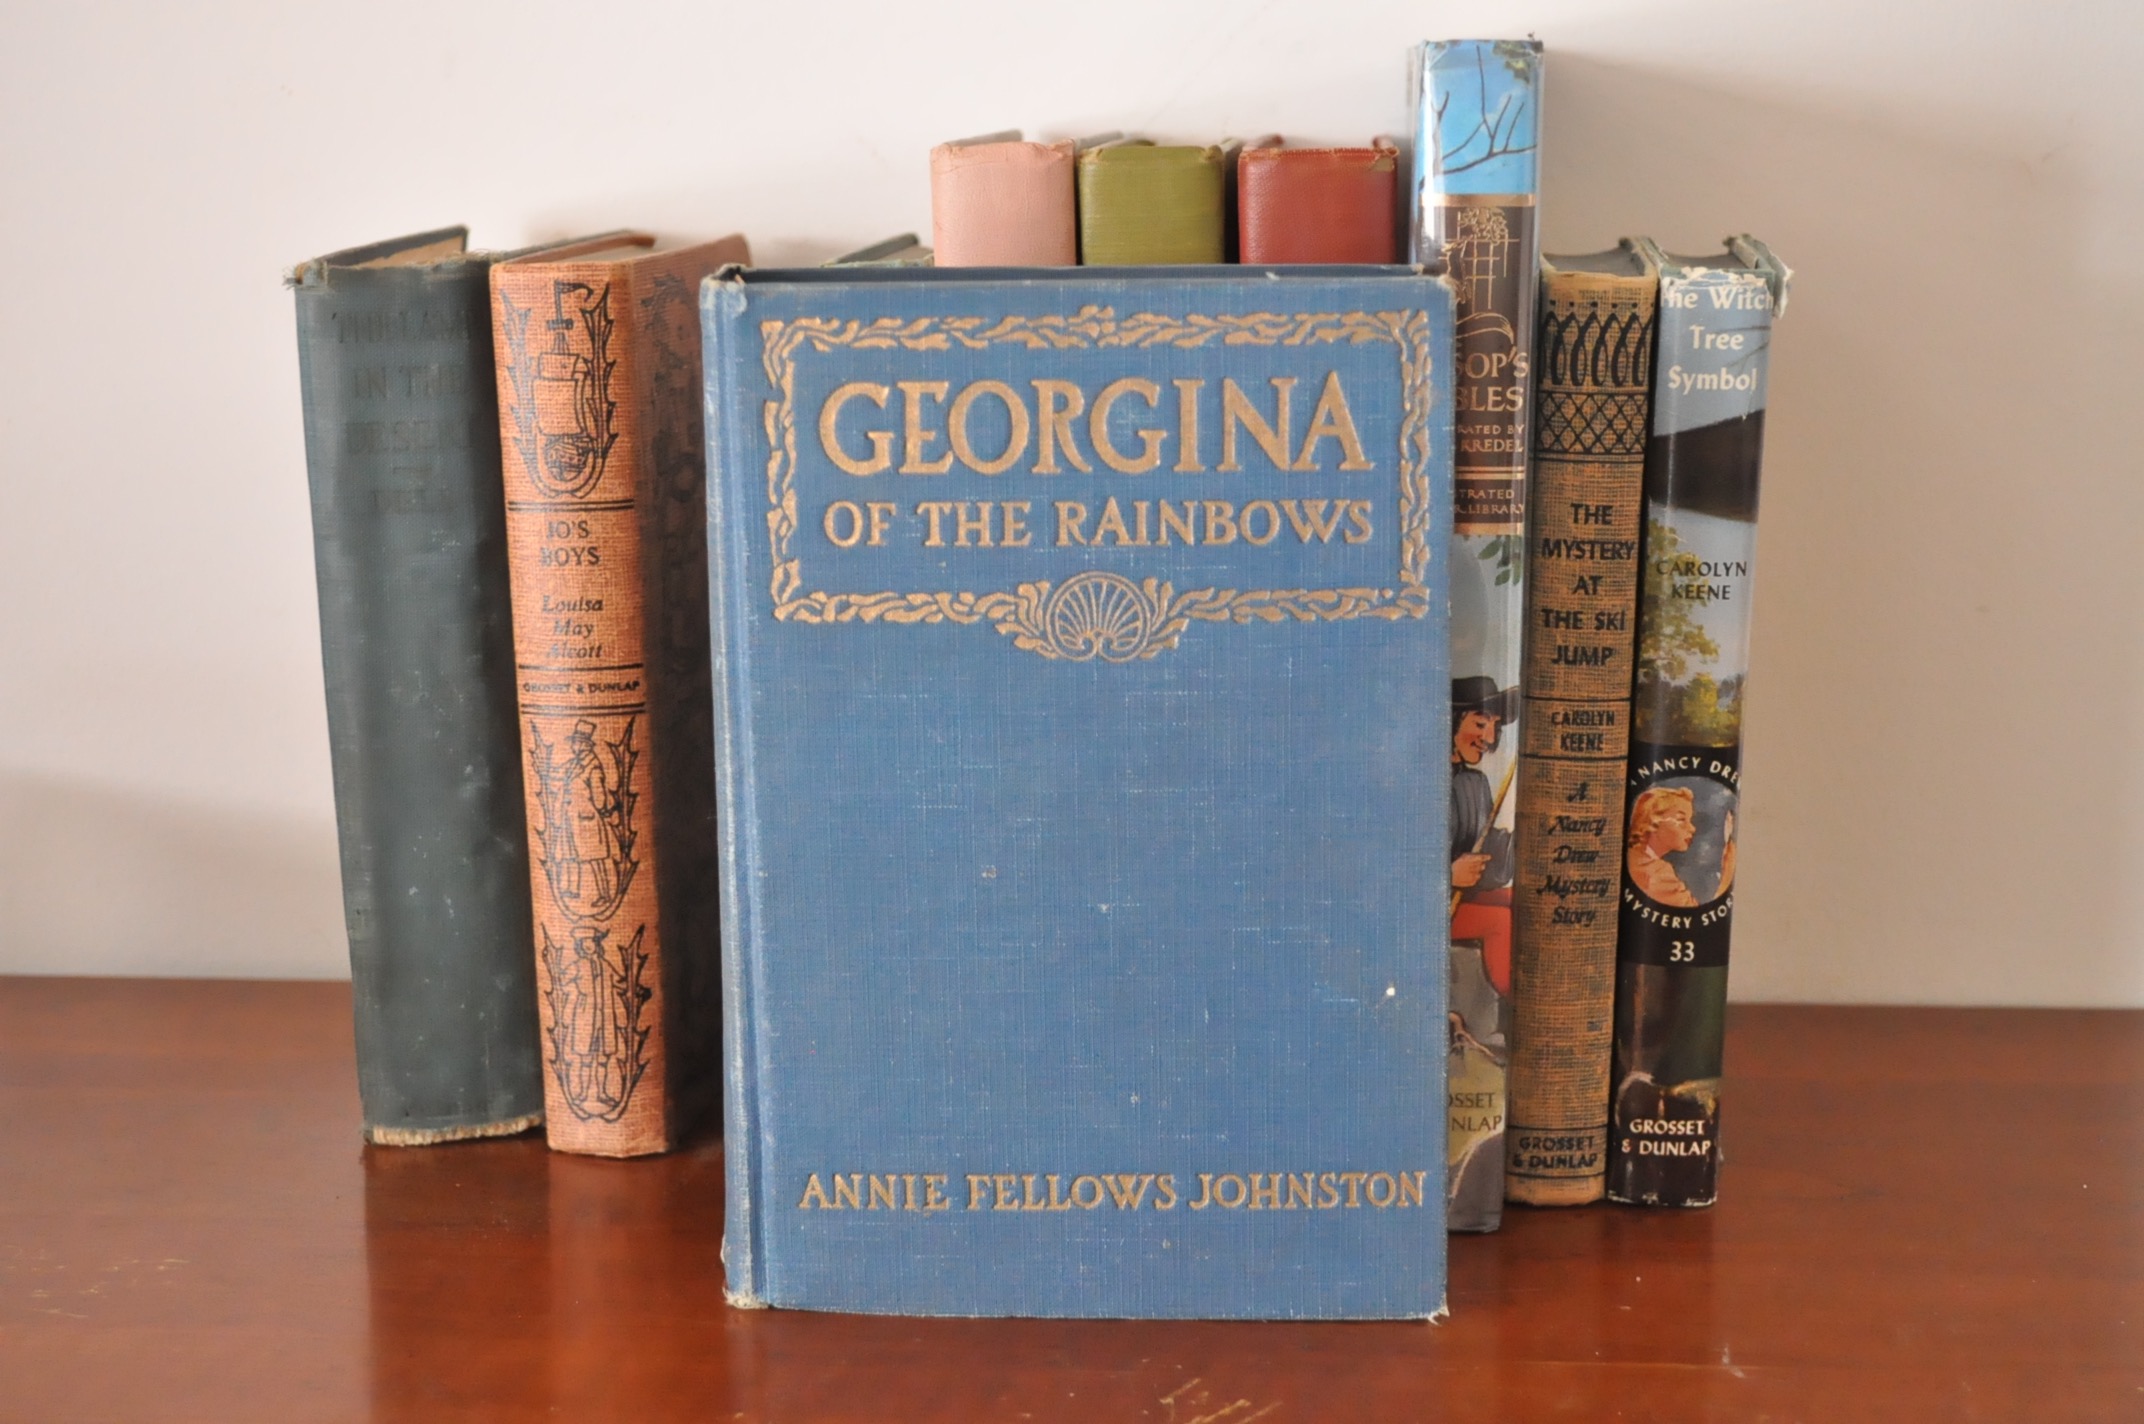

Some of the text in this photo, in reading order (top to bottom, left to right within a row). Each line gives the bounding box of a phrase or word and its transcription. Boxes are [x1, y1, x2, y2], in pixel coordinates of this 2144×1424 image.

[1689, 324, 1744, 350] Tree
[1668, 365, 1757, 395] Symbol
[819, 371, 1375, 476] GEORGINA
[1507, 423, 1525, 435] BY
[1461, 438, 1524, 452] KREDEL
[1468, 503, 1524, 515] LIBRARY
[1570, 502, 1613, 525] THE
[547, 520, 590, 540] JO'S
[824, 497, 1374, 548] OF THE RAINBOWS
[540, 546, 600, 567] BOYS
[1541, 538, 1635, 560] MYSTERY
[1656, 560, 1748, 577] CAROLYN
[1573, 575, 1603, 595] AT
[1671, 584, 1731, 600] KEENE
[542, 595, 603, 613] Louisa
[553, 618, 594, 639] May
[1541, 608, 1625, 631] THE SKI
[546, 640, 603, 659] Alcott
[1551, 645, 1615, 666] JUMP
[576, 683, 584, 694] &
[588, 680, 640, 694] DUNLAP
[1551, 711, 1615, 727] CAROLYN
[1560, 732, 1604, 751] KEENE
[1637, 756, 1702, 778] NANCY
[1568, 782, 1588, 802] A
[1548, 815, 1608, 837] Nancy
[1553, 845, 1600, 864] Drew
[1536, 874, 1611, 900] Mystery
[1552, 905, 1596, 927] Story
[1669, 941, 1695, 962] 33
[1451, 1115, 1503, 1131] NLAP
[1629, 1119, 1705, 1135] GROSSET
[1519, 1135, 1596, 1150] GROSSET
[1621, 1139, 1712, 1156] & DUNLAP
[1512, 1153, 1598, 1169] & DUNLAP
[800, 1171, 1428, 1211] ANNIE FELLOWS JOHNSTON
